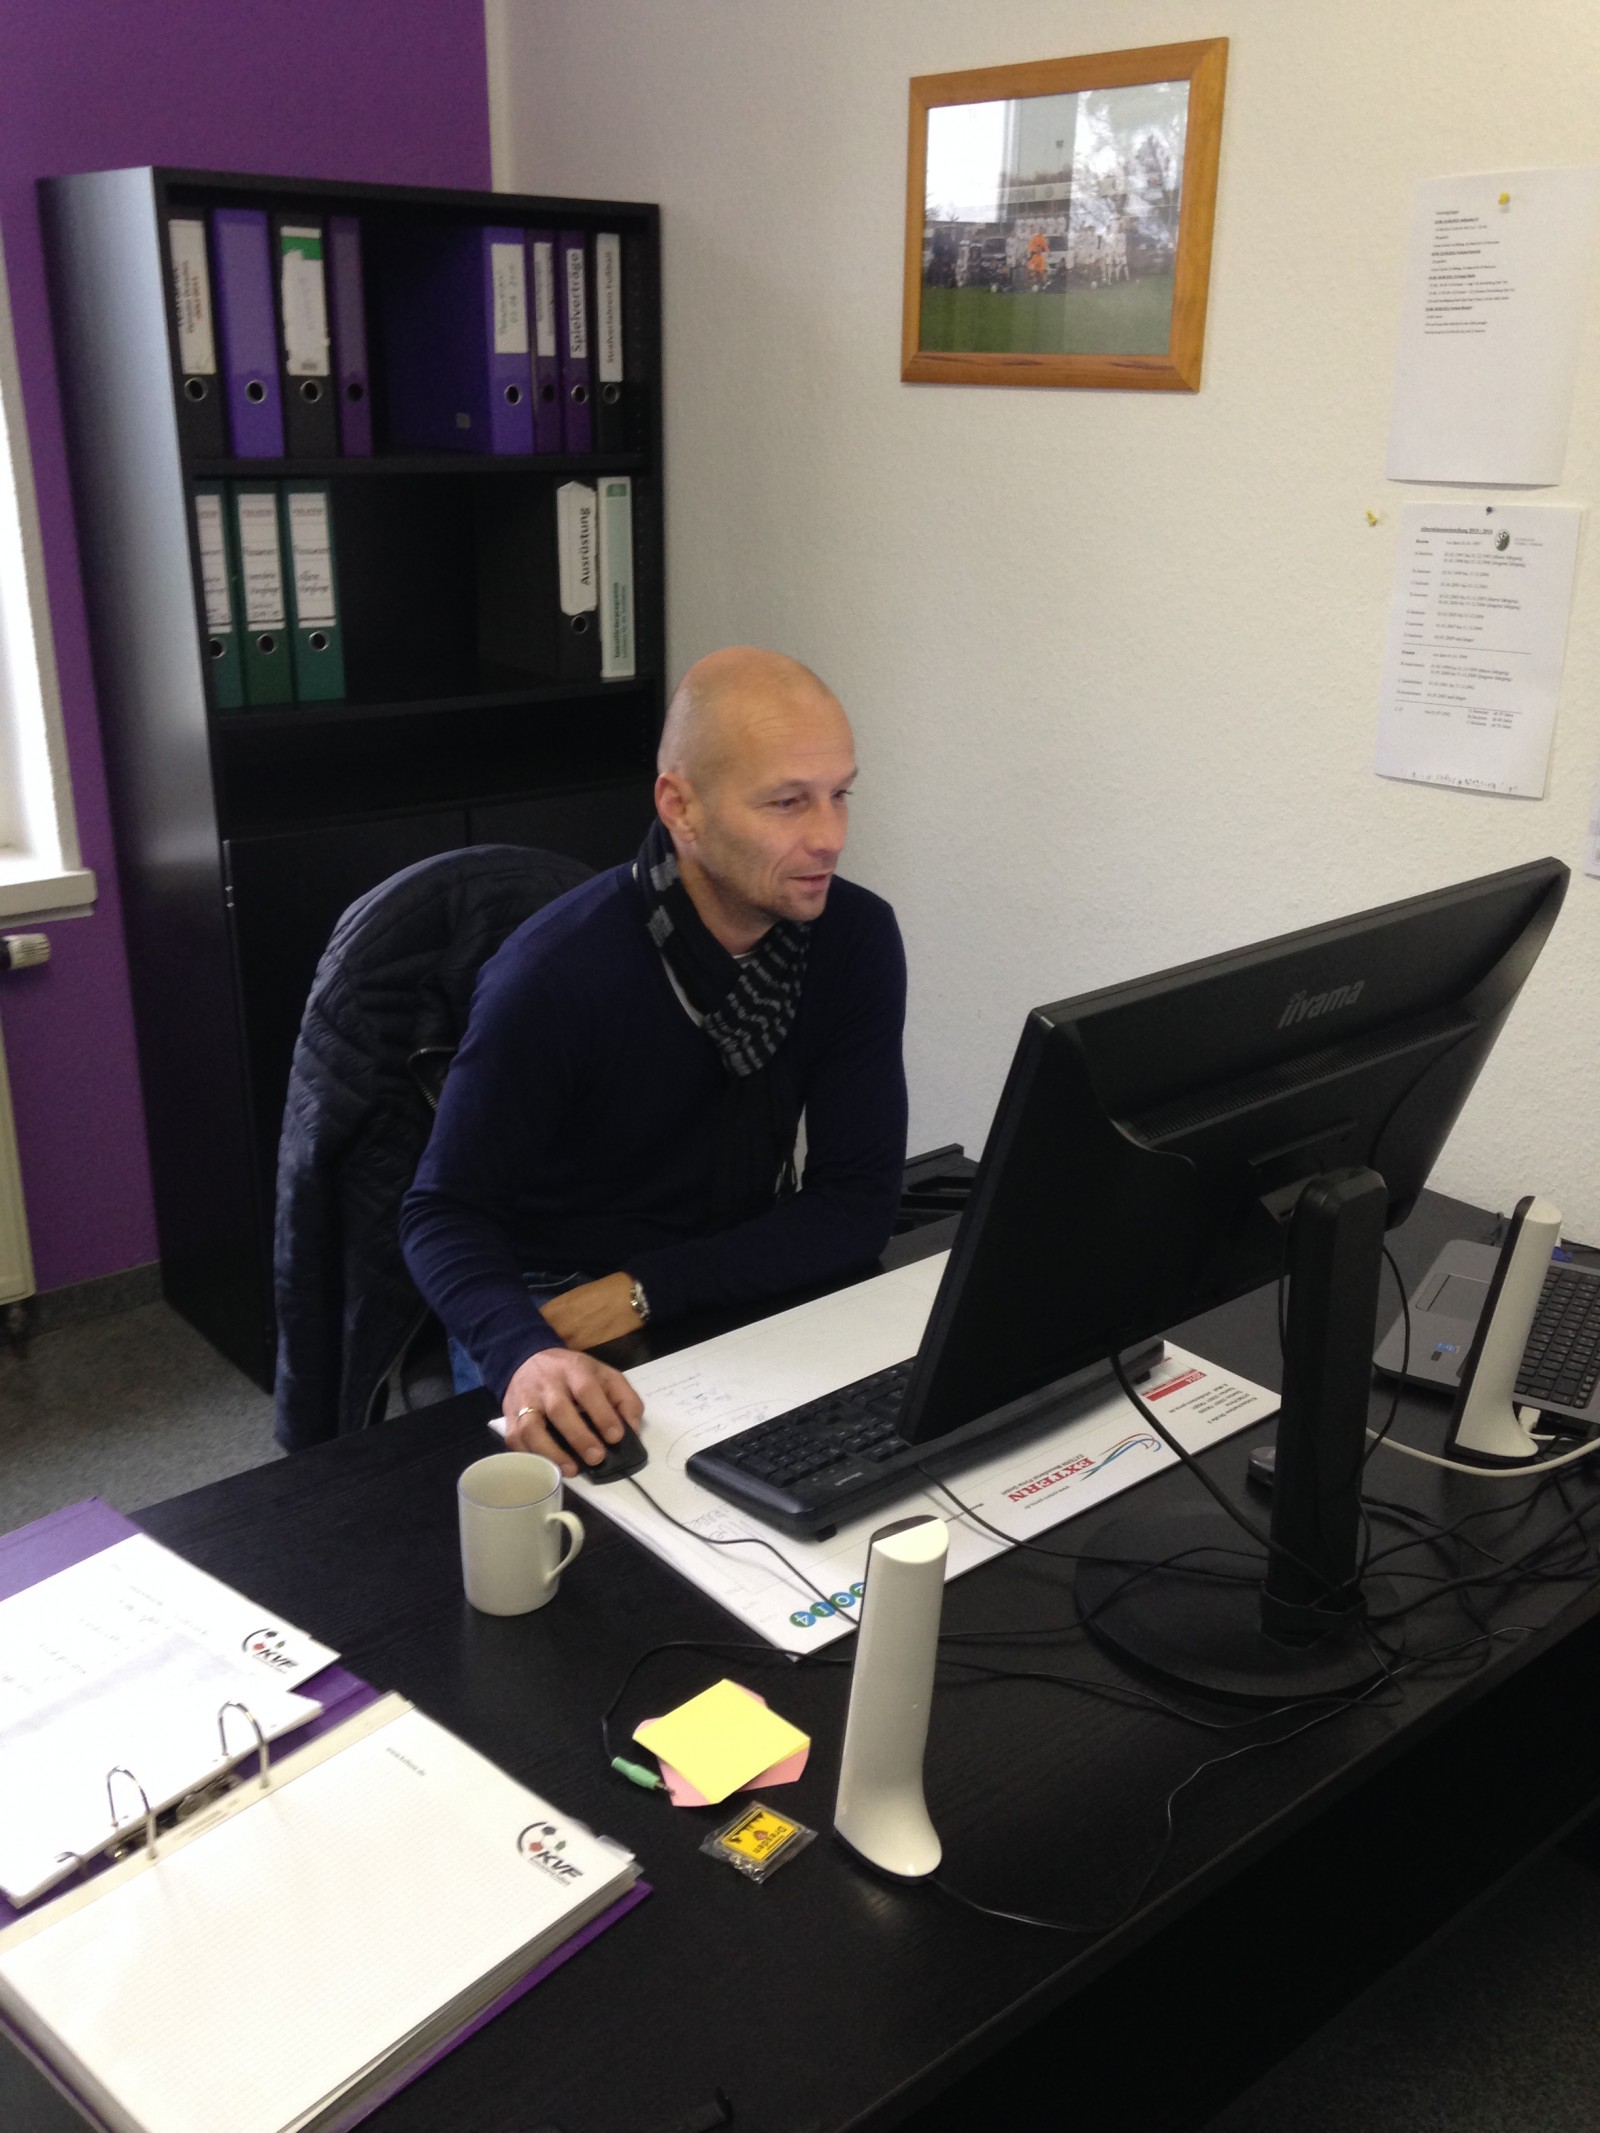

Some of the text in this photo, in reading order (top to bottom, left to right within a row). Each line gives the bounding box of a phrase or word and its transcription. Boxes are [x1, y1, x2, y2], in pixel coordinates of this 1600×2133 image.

[570, 251, 584, 353] Spielverträge
[579, 507, 591, 586] Ausrüstung
[1277, 980, 1366, 1029] iiyama
[1008, 1458, 1095, 1502] EXTERN
[256, 1648, 299, 1668] KVF
[753, 1826, 787, 1853] Dresden
[536, 1850, 584, 1878] KVF
